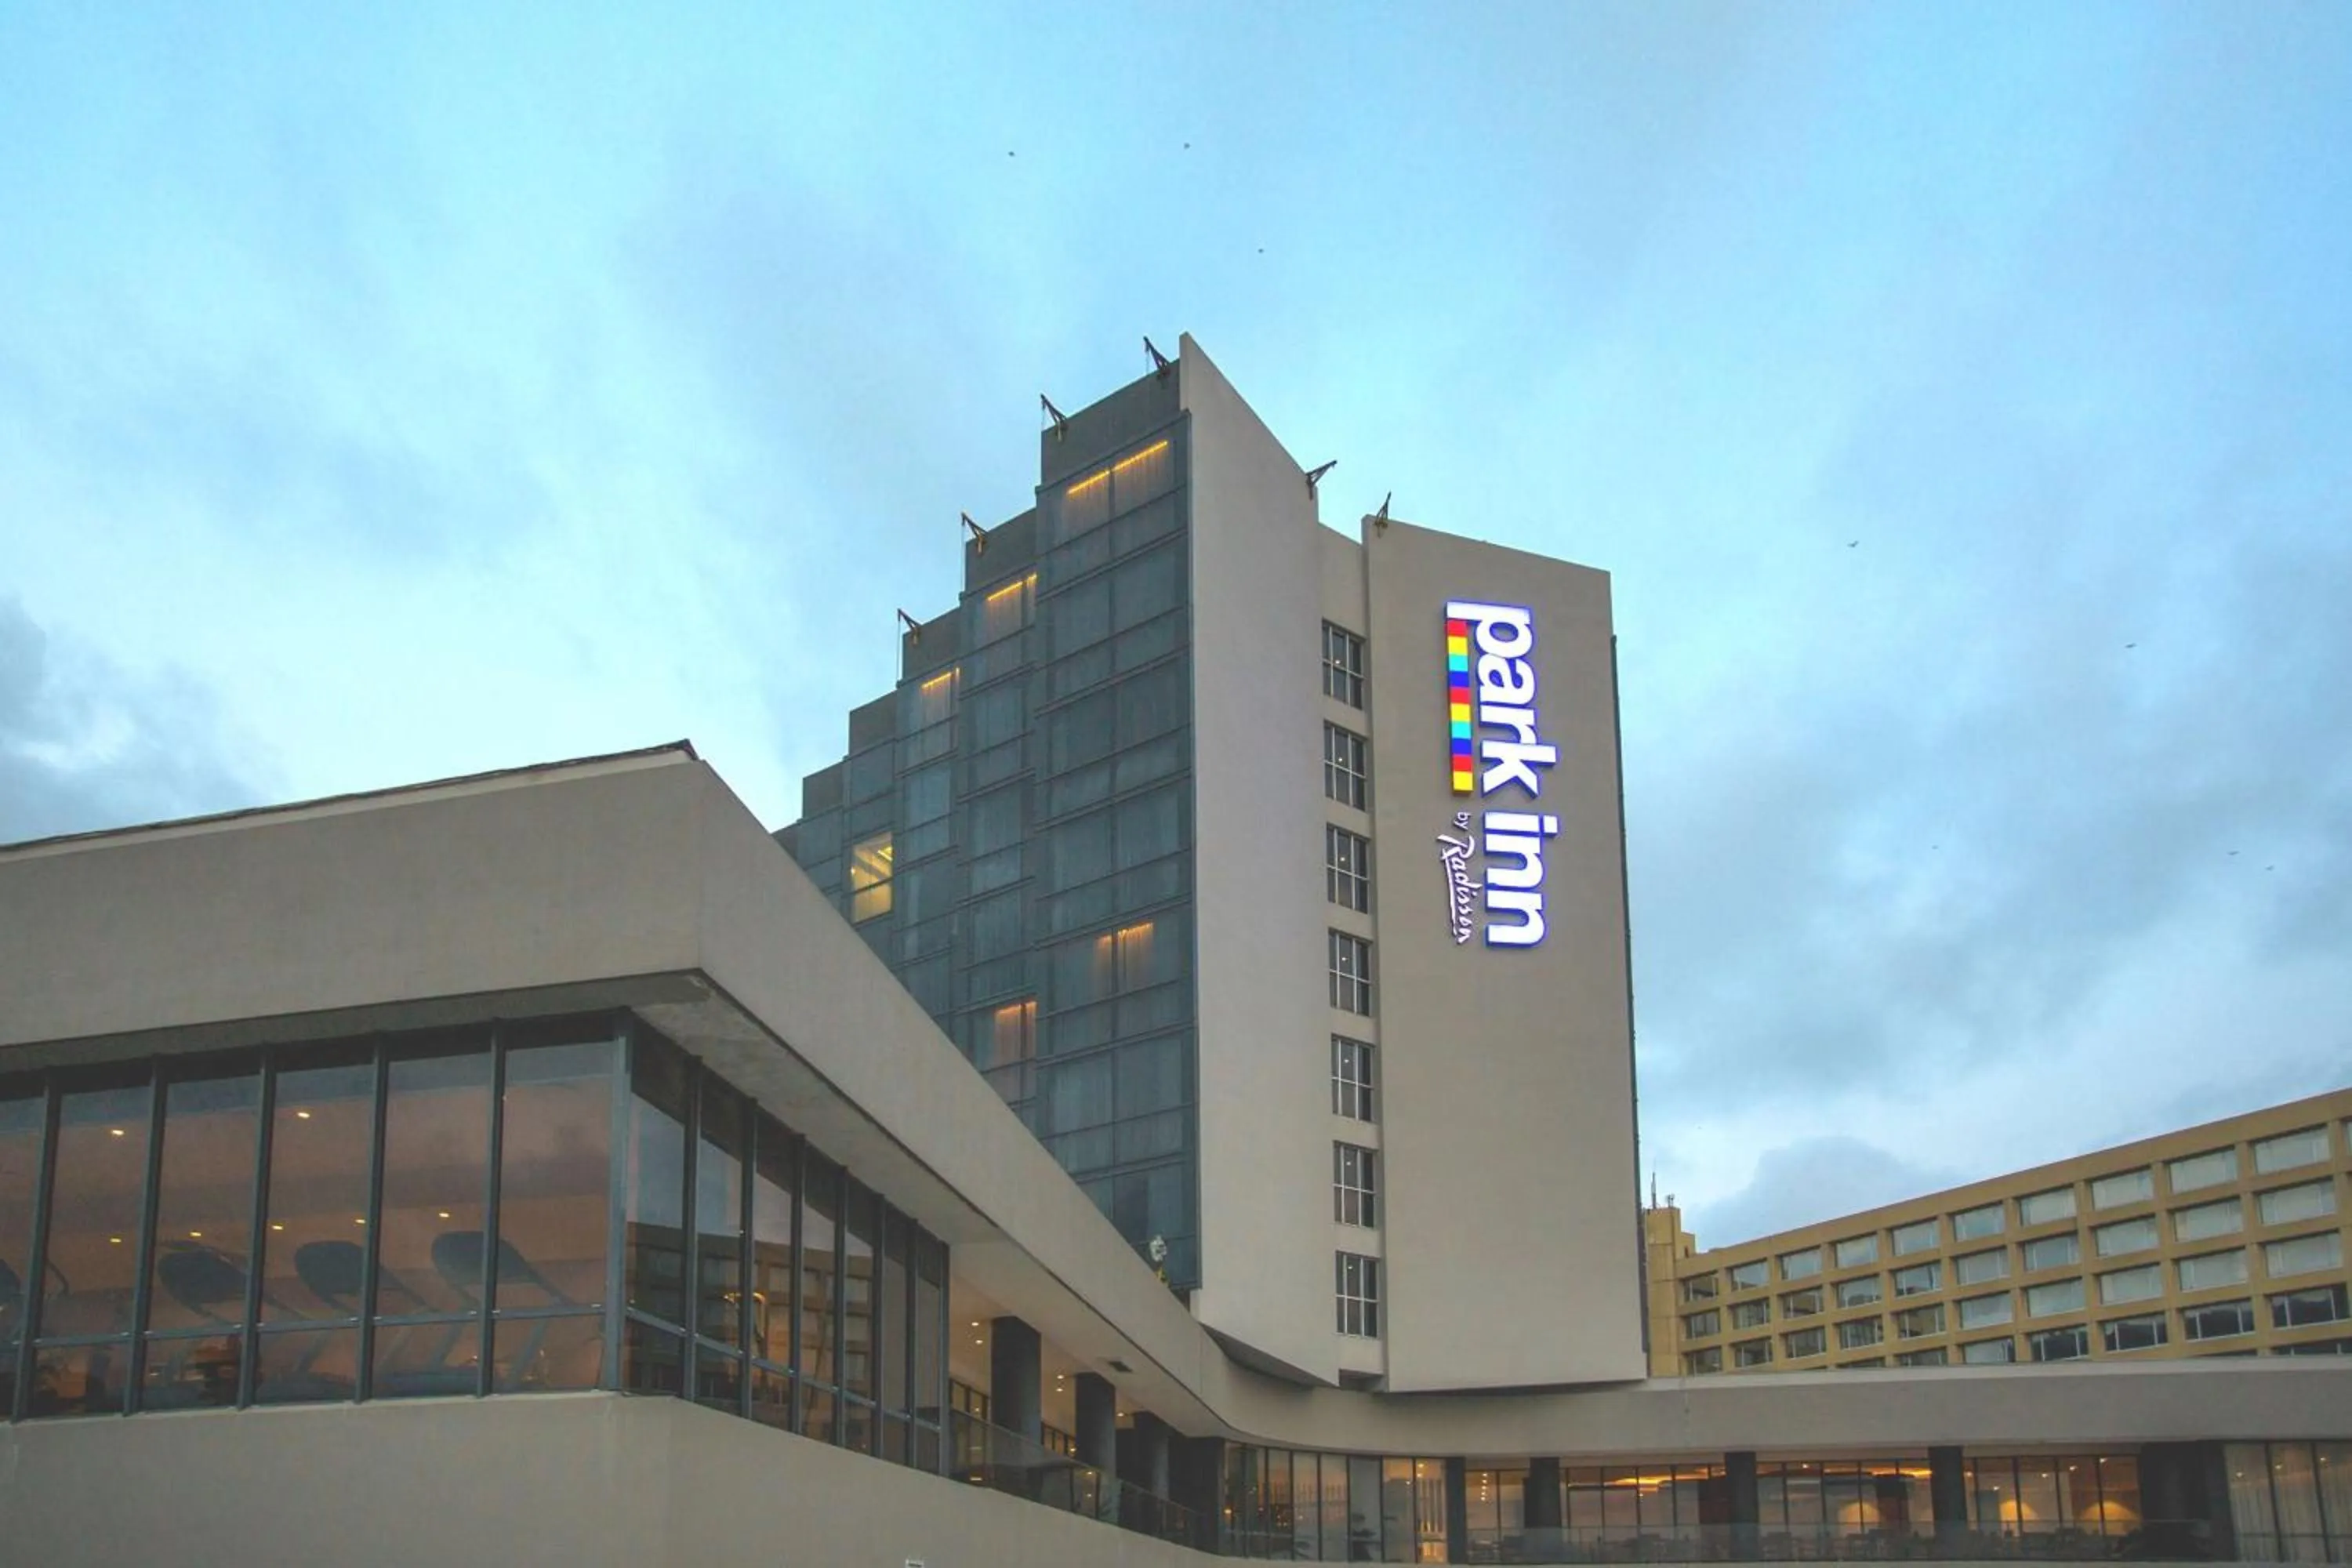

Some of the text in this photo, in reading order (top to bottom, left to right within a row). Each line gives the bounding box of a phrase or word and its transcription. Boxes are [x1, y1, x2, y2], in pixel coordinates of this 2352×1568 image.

[1437, 811, 1482, 944] by Radisson
[1445, 601, 1559, 946] park inn
